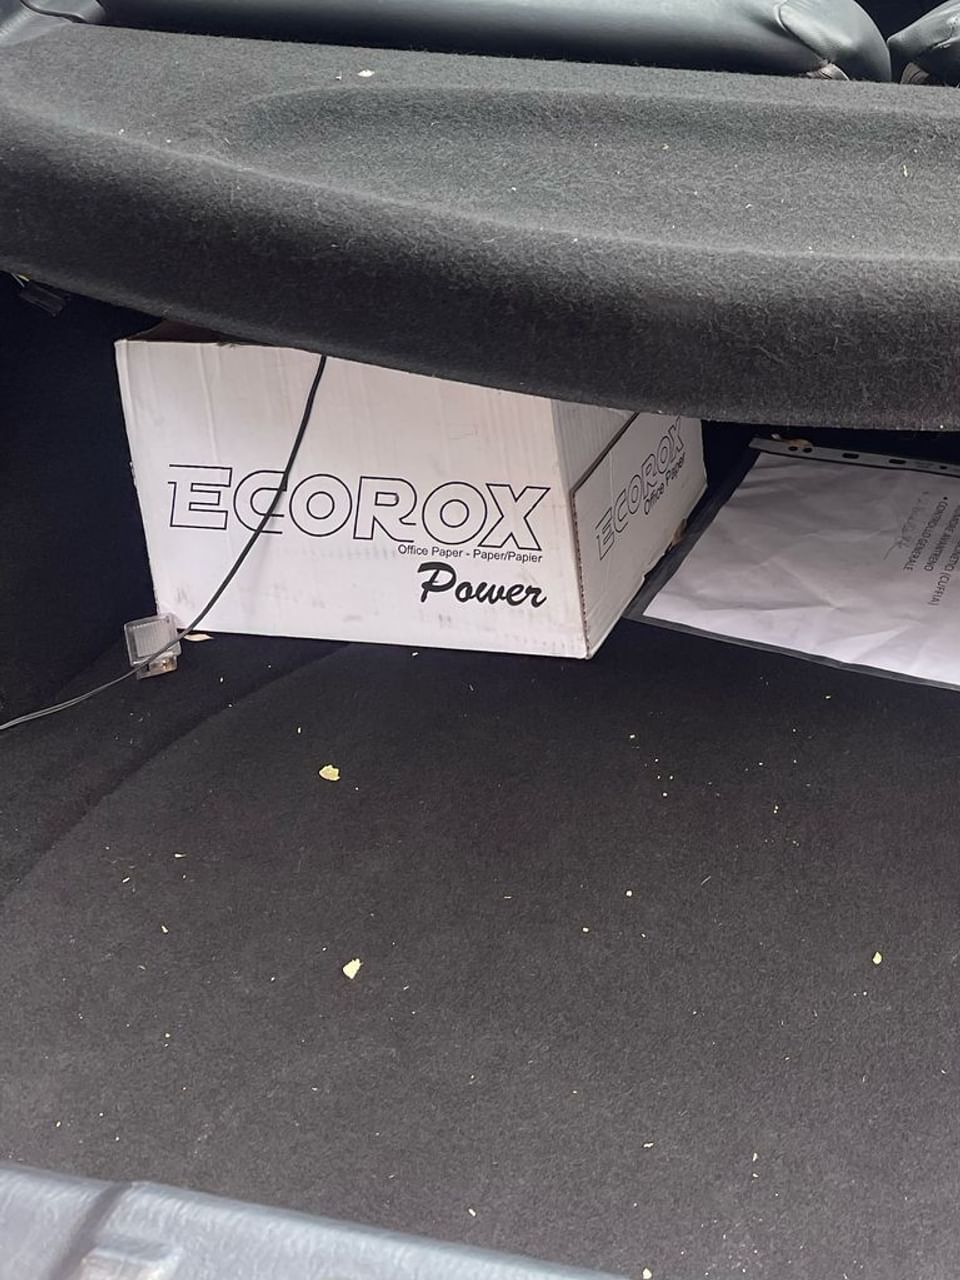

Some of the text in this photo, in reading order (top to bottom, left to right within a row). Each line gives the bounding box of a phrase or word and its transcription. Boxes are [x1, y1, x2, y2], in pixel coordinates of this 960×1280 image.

[167, 463, 551, 551] ECOROX
[594, 415, 684, 561] ECOROX
[644, 451, 686, 516] Office Paper
[398, 544, 429, 556] Office
[431, 545, 463, 558] Paper
[473, 548, 543, 564] Paper/Papier
[417, 561, 548, 608] Power
